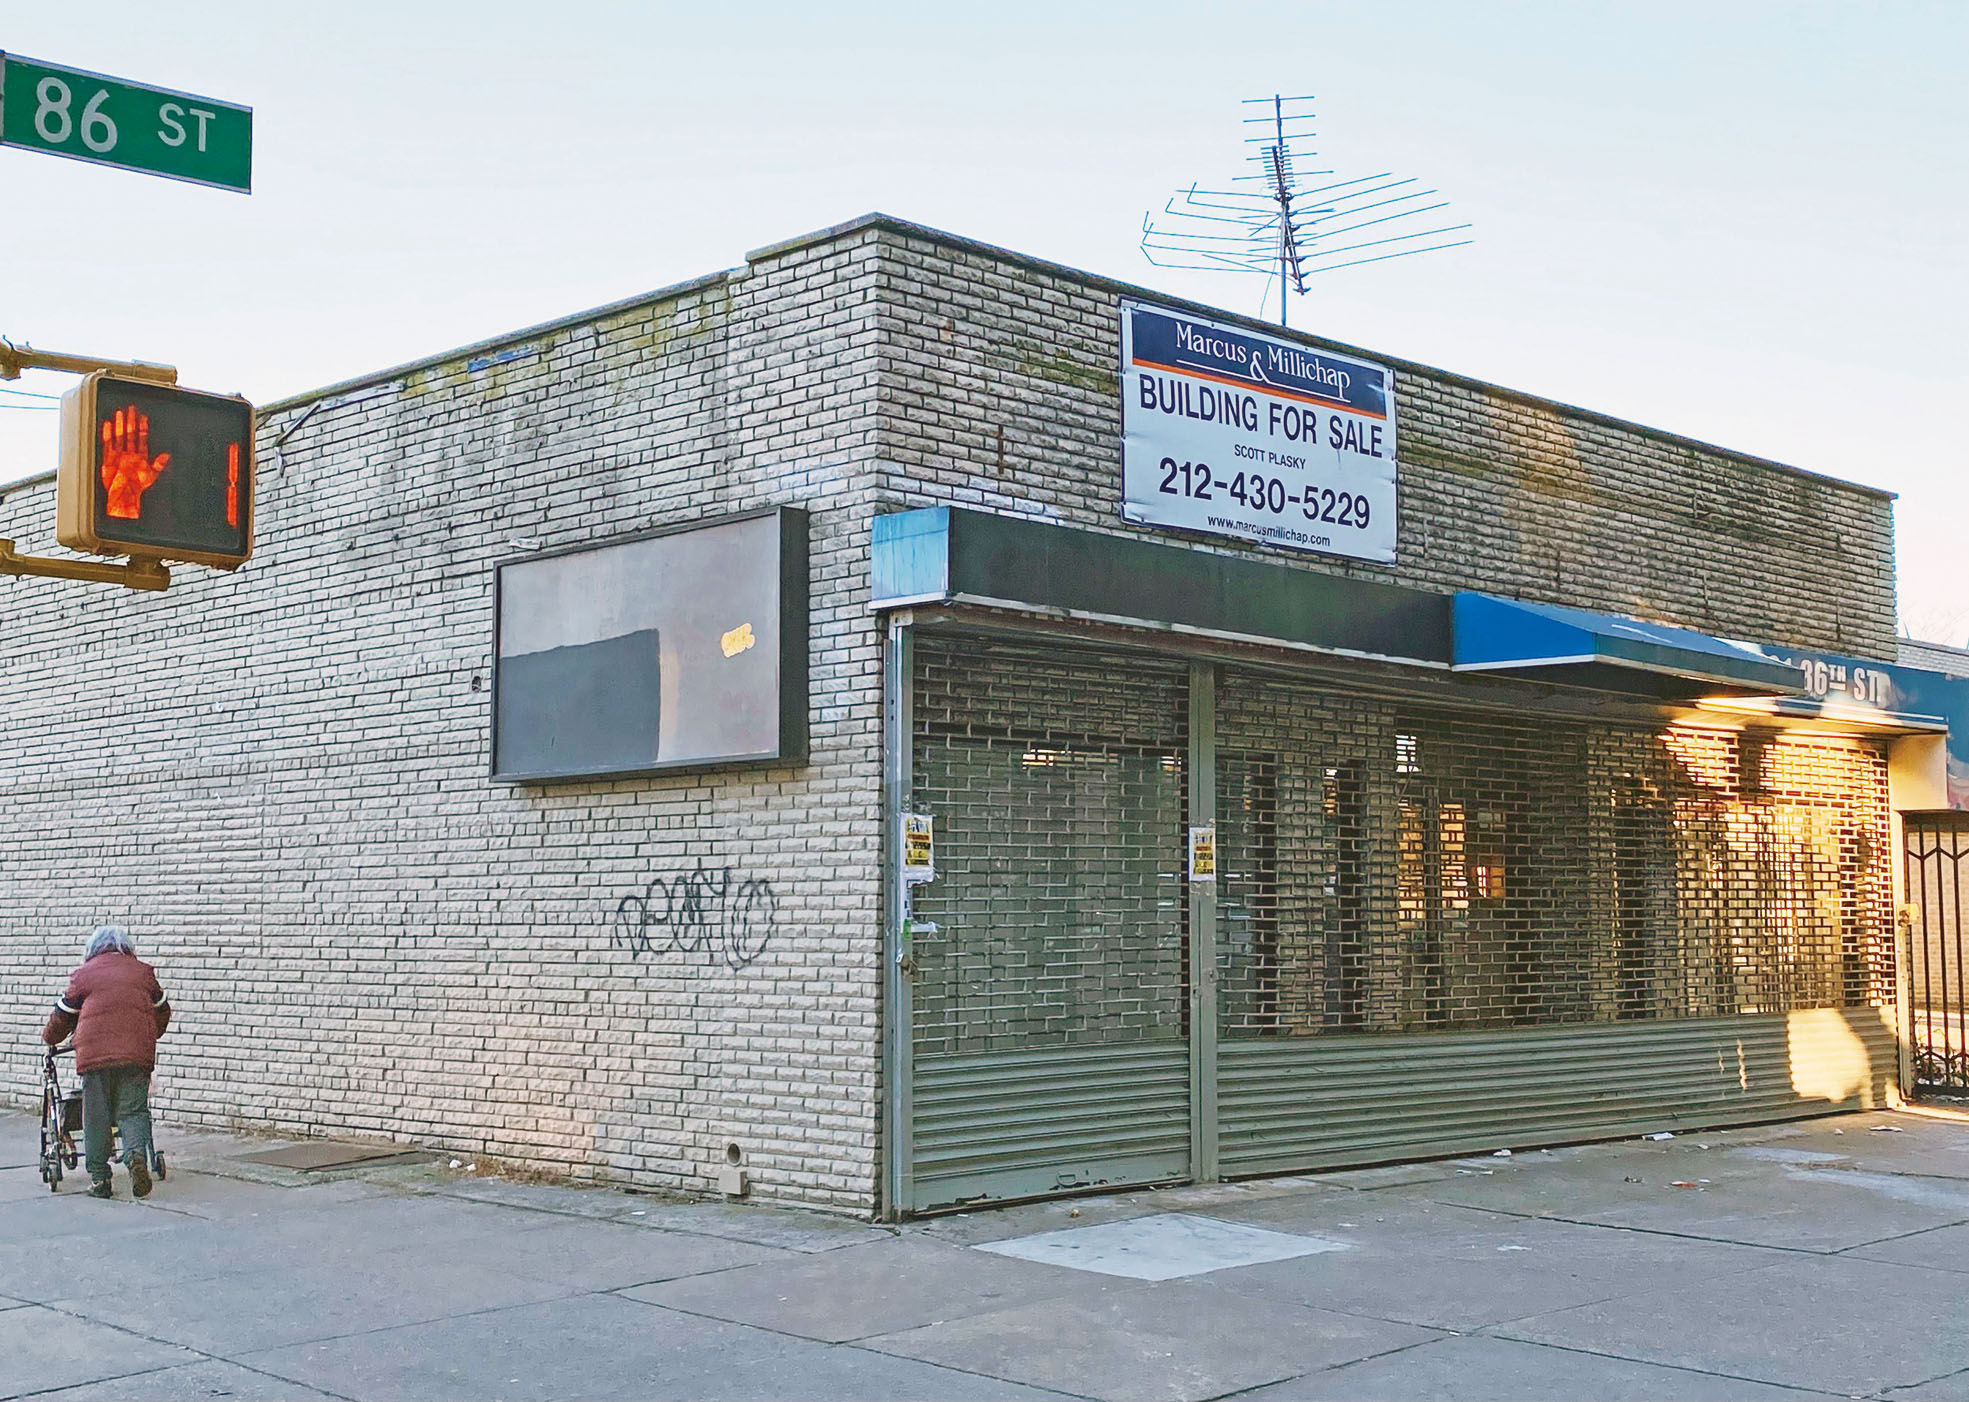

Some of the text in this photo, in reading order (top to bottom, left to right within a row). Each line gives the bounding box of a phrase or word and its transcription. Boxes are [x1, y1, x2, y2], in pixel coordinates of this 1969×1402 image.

[35, 77, 216, 153] 86 ST
[1176, 322, 1351, 399] Marcus & Millichap
[1139, 374, 1383, 458] BUILDING FOR SALE
[1159, 457, 1370, 530] 212-430-5229
[1234, 444, 1306, 470] SCOTT PLASKY
[1207, 516, 1331, 547] www.marcusmillichap.com
